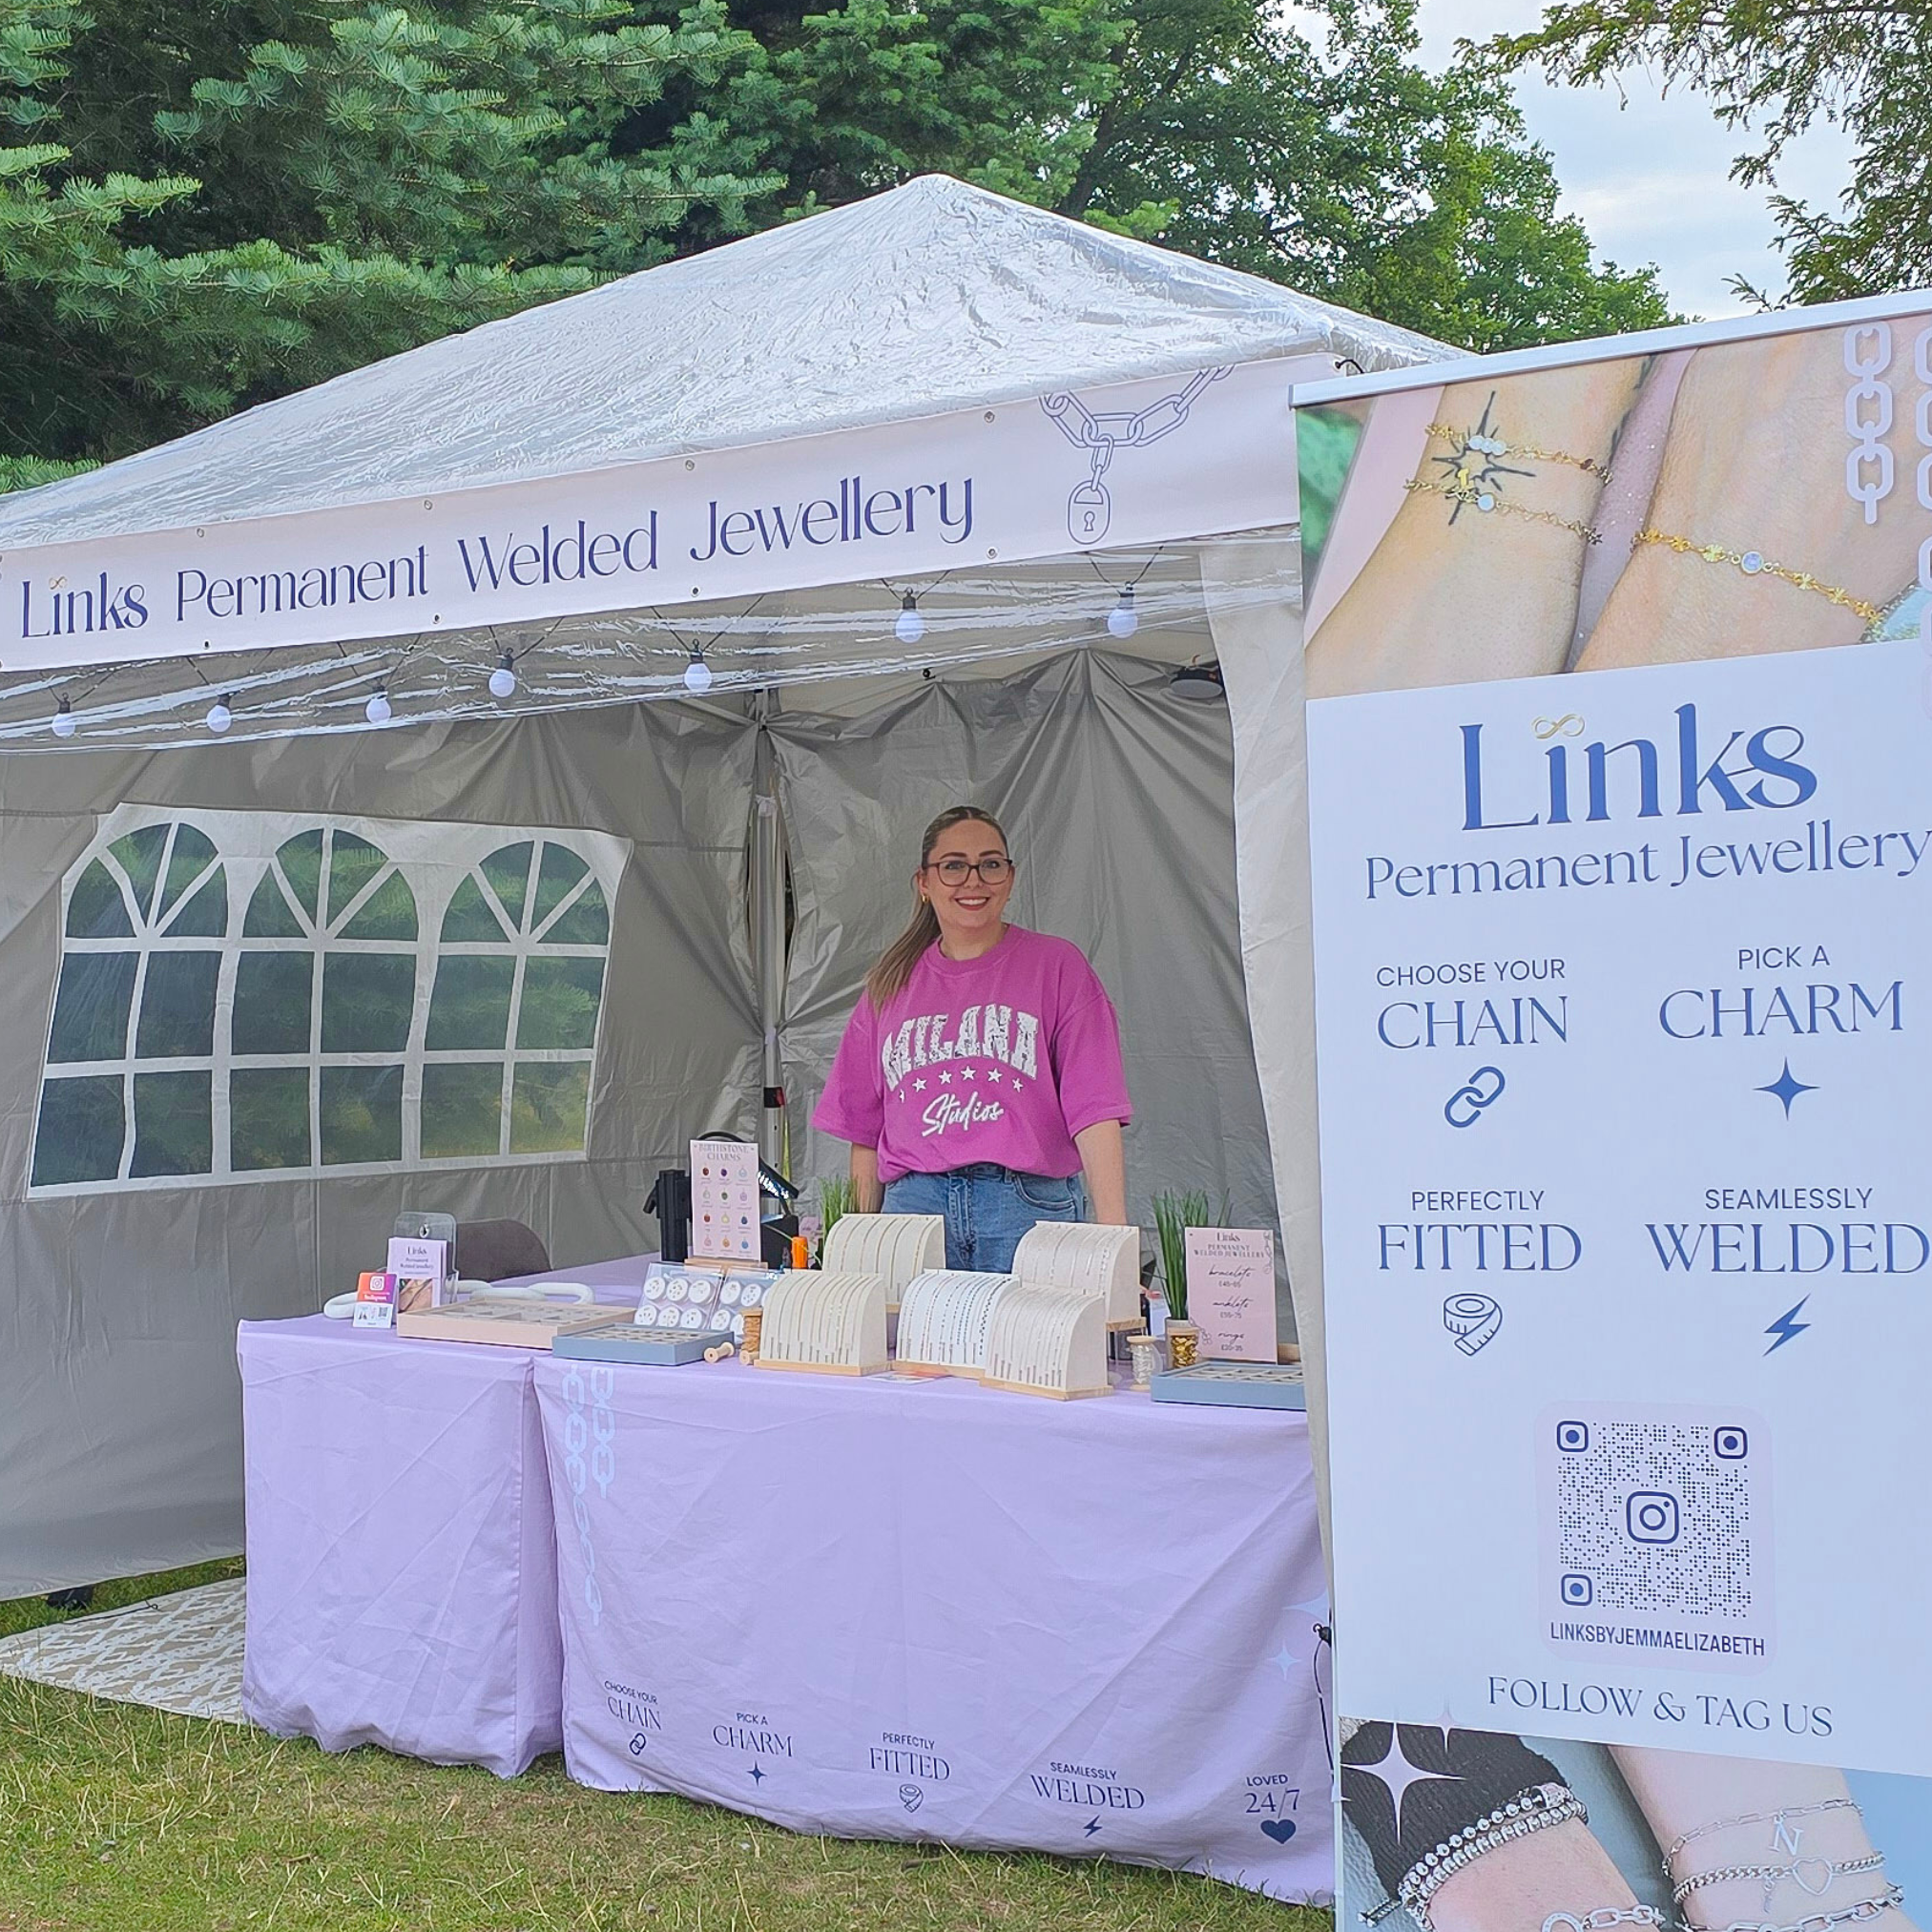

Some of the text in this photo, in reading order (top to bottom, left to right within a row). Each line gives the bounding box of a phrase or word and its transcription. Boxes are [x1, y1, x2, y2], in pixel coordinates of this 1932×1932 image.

[22, 475, 974, 638] Links Permanent Welded Jewellery
[1459, 702, 1818, 831] Links
[1365, 819, 1932, 900] Permanent Jewellery
[1376, 958, 1567, 987] CHOOSE YOUR
[1737, 945, 1831, 970] PICK A
[1377, 995, 1568, 1050] CHAIN
[1659, 980, 1904, 1040] CHARM
[881, 1004, 1039, 1092] MILANA
[921, 1091, 1005, 1137] Studios
[1410, 1189, 1545, 1212] PERFECTLY
[1704, 1187, 1874, 1211] SEAMLESSLY
[1377, 1223, 1583, 1272] FITTED
[1644, 1223, 1931, 1275] WELDED
[1549, 1621, 1766, 1657] LINKSBYJEMMAELIZABETH
[604, 1680, 658, 1706] CHOOSE YOUR
[1486, 1675, 1834, 1738] FOLLOW & TAG US
[607, 1696, 662, 1731] CHAIN
[736, 1712, 769, 1726] PICK A
[713, 1725, 794, 1757] CHARM
[882, 1732, 936, 1751] PERFECTLY
[868, 1747, 951, 1782] FITTED
[1049, 1761, 1118, 1781] SEAMLESSLY
[1245, 1774, 1289, 1788] LOVED
[1030, 1774, 1146, 1810] WELDED
[1244, 1788, 1301, 1819] 24/7
